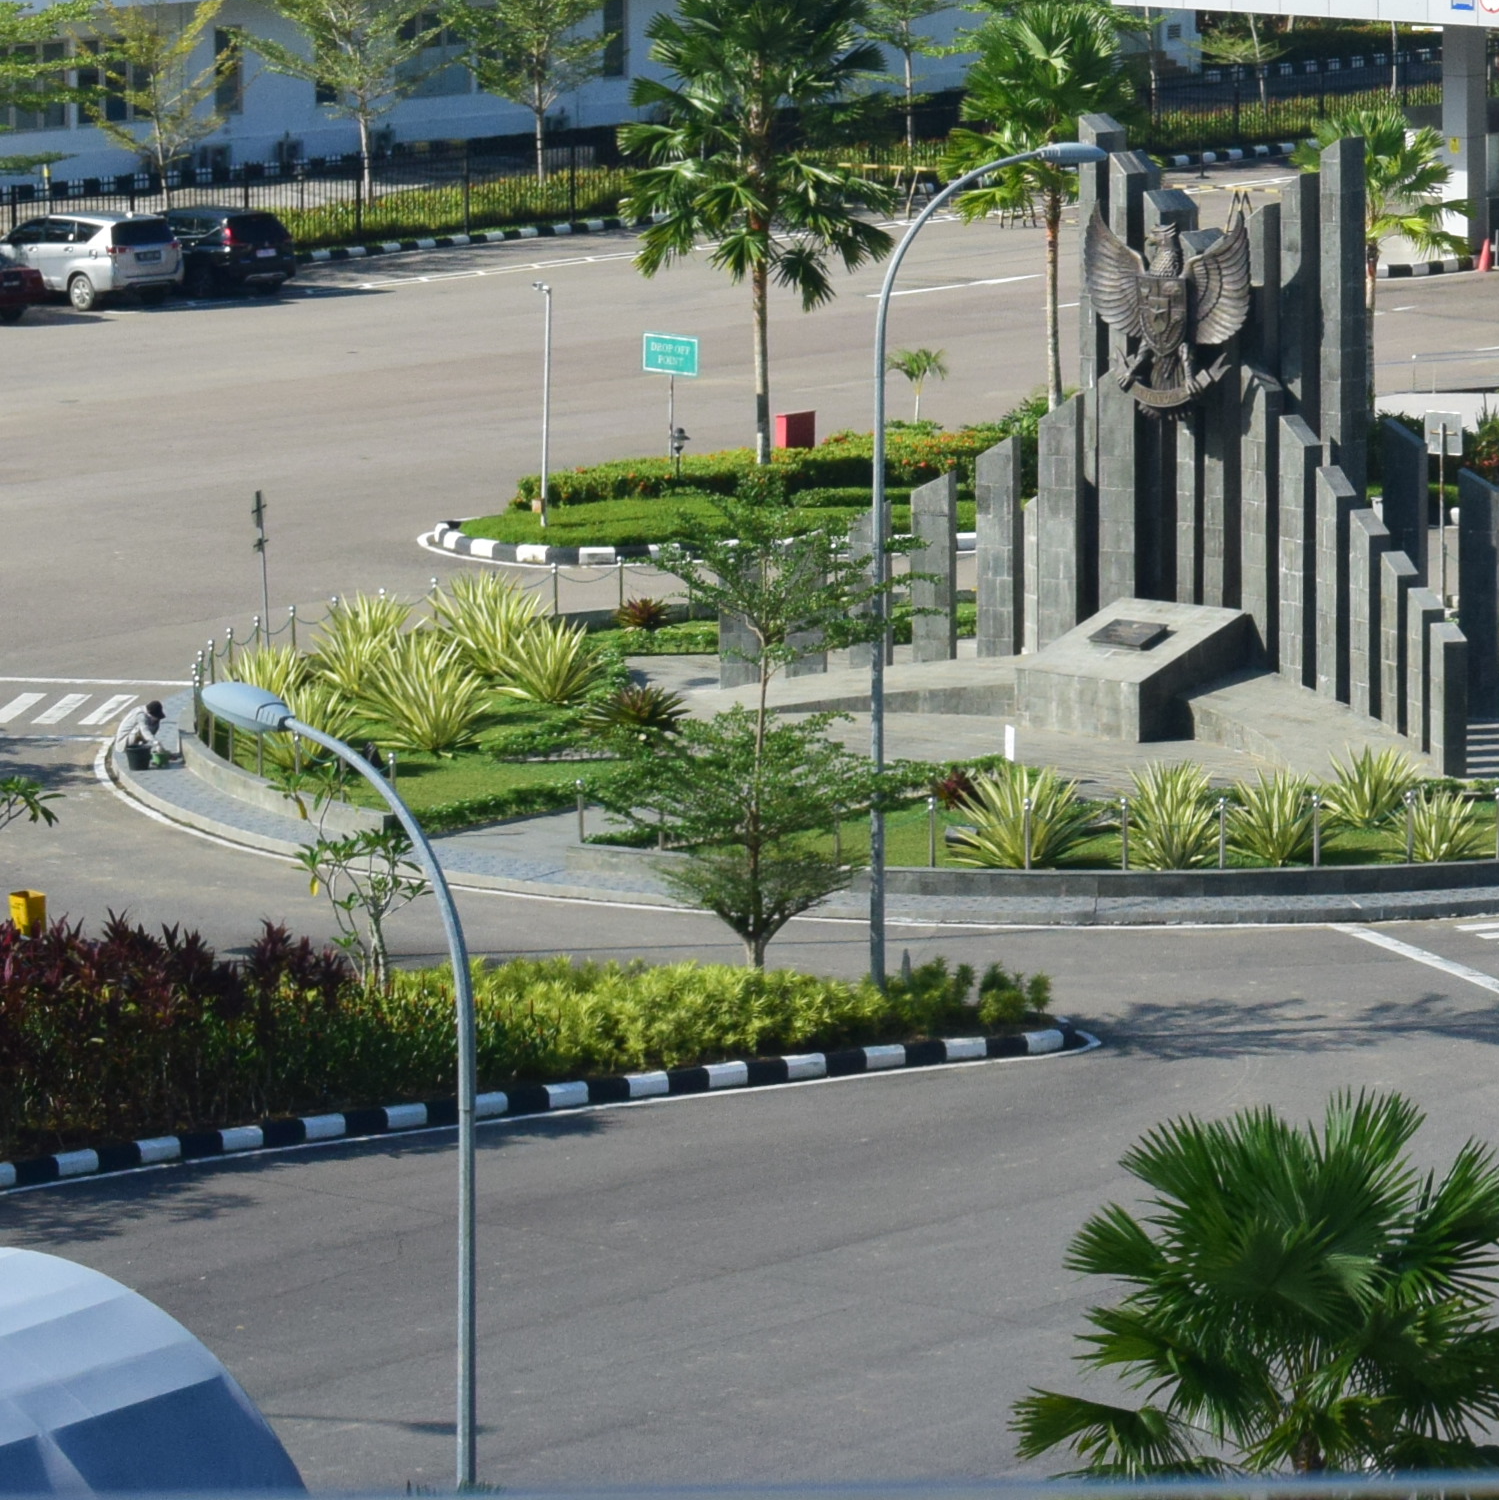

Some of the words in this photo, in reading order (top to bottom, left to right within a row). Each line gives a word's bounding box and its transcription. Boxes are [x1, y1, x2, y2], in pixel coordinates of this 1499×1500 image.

[651, 341, 673, 352] DROP
[674, 345, 690, 355] OFF
[658, 354, 684, 367] POINT
